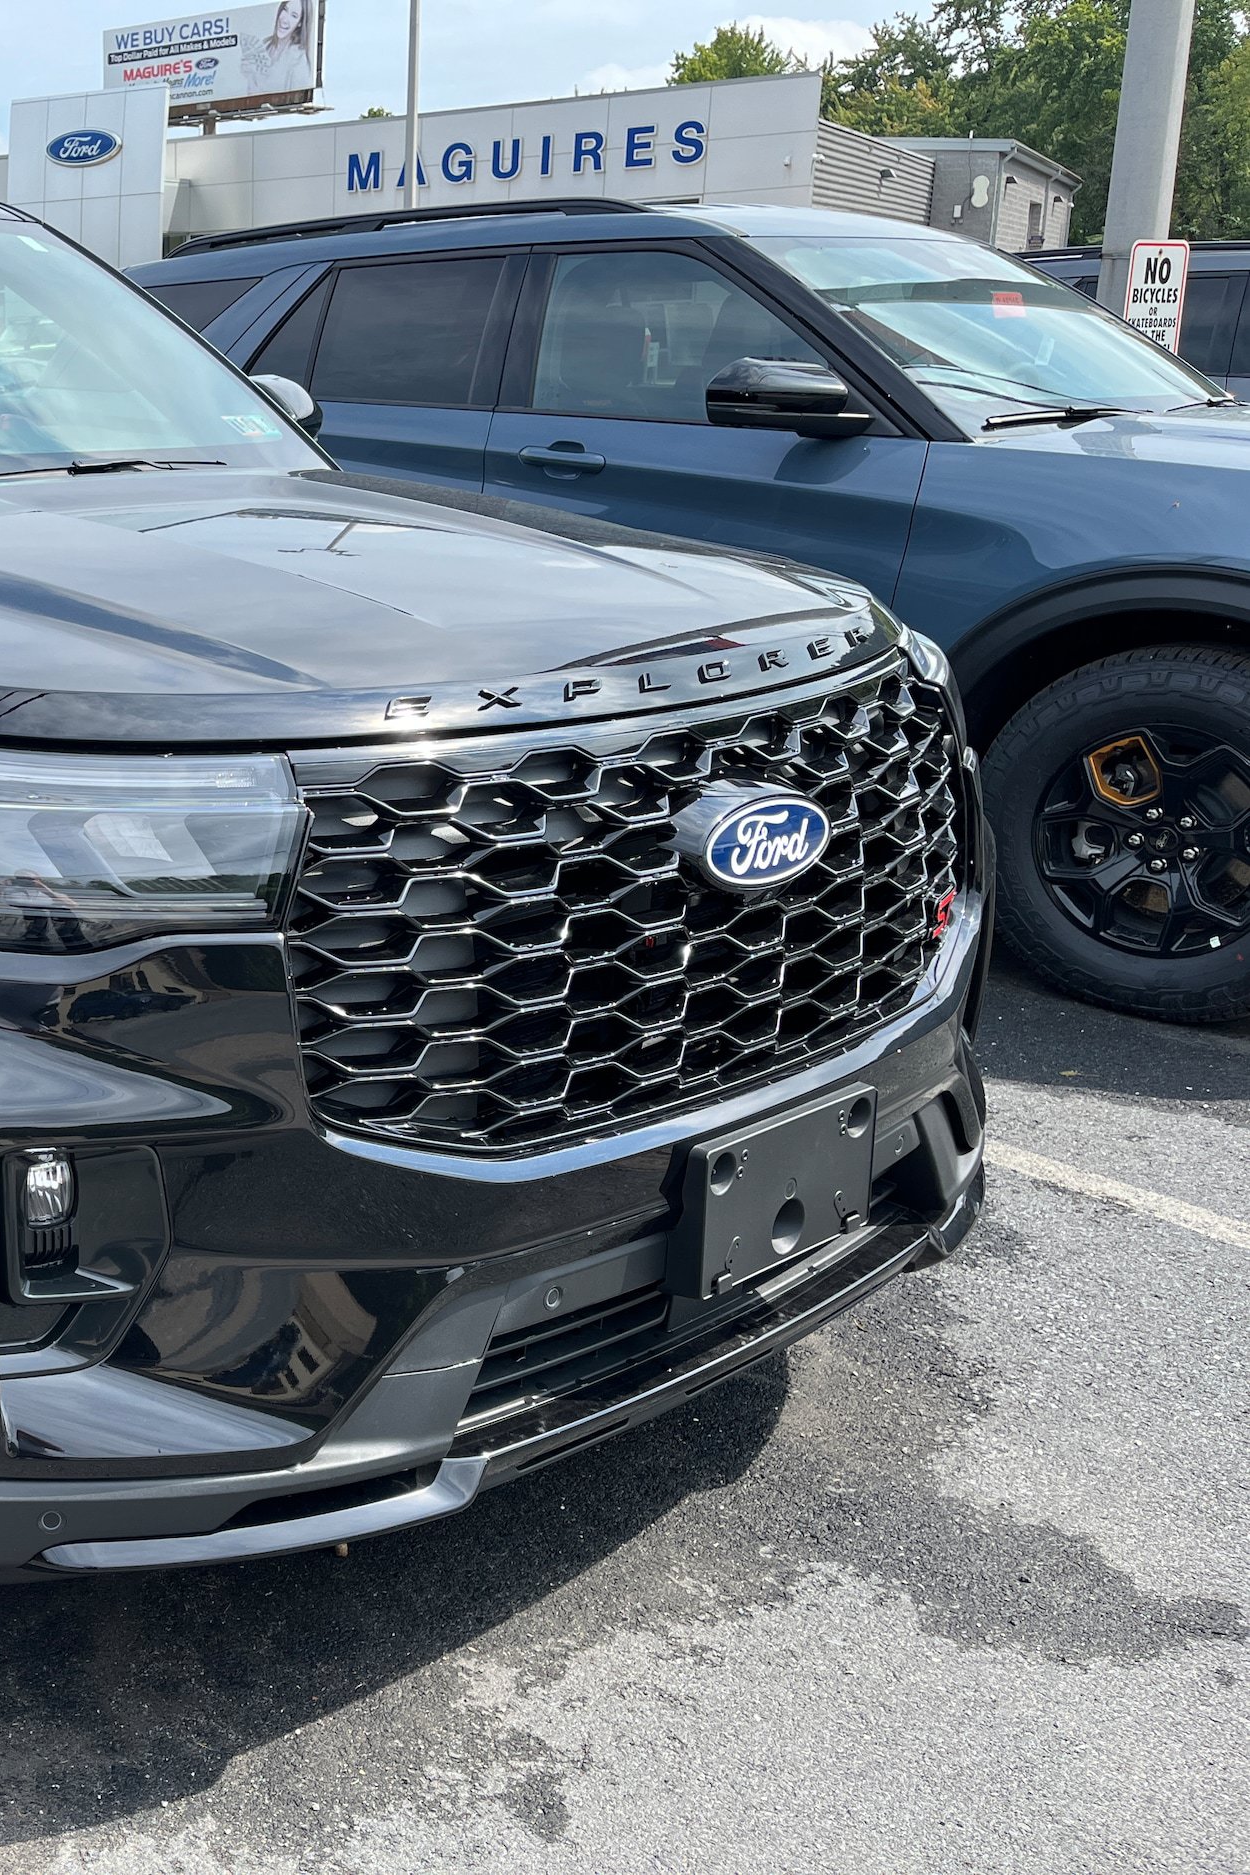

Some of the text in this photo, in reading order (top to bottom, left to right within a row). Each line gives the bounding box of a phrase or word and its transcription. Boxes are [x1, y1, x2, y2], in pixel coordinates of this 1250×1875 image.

[115, 17, 229, 50] WE BUY CARS!
[110, 54, 123, 63] Top
[123, 51, 142, 61] Dollar
[143, 48, 158, 58] Paid
[159, 46, 169, 56] for
[170, 44, 179, 54] All
[180, 41, 202, 53] Makes
[210, 36, 236, 49] Models
[123, 59, 193, 82] MAGUIRE'S
[183, 70, 217, 88] More!
[59, 136, 102, 159] Ford
[1144, 257, 1172, 285] NO
[1132, 288, 1178, 303] BICYCLES
[1148, 307, 1158, 316] OR
[1151, 330, 1166, 342] THE
[385, 625, 870, 722] EXPLORER
[731, 810, 810, 875] Ford
